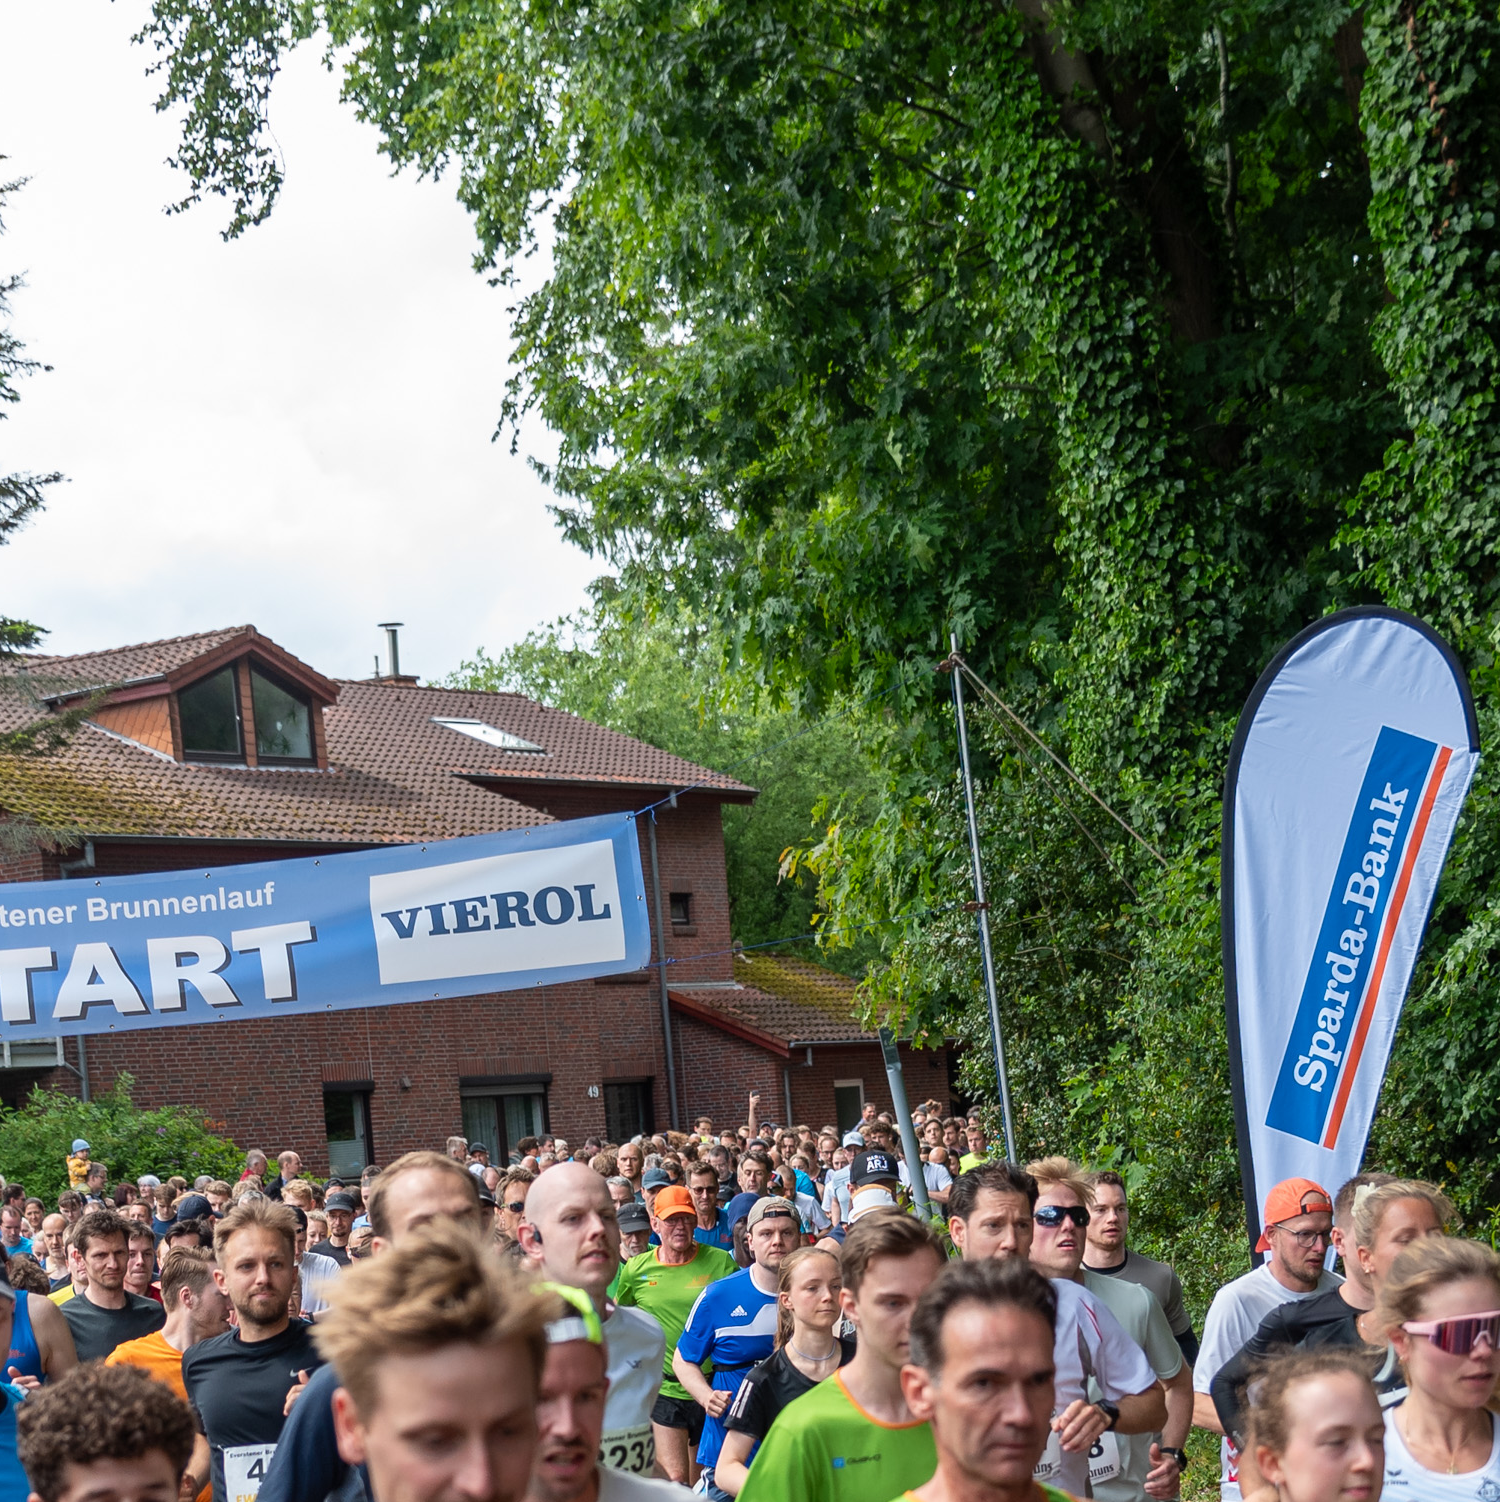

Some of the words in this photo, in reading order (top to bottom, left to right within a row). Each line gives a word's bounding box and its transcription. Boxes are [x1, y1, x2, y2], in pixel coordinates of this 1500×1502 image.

[87, 881, 275, 922] Brunnenlauf
[381, 884, 611, 939] VIEROL
[1294, 782, 1409, 1093] Sparda-Bank
[587, 1085, 599, 1098] 49
[866, 1159, 888, 1171] ARJ
[1033, 1462, 1053, 1474] uns
